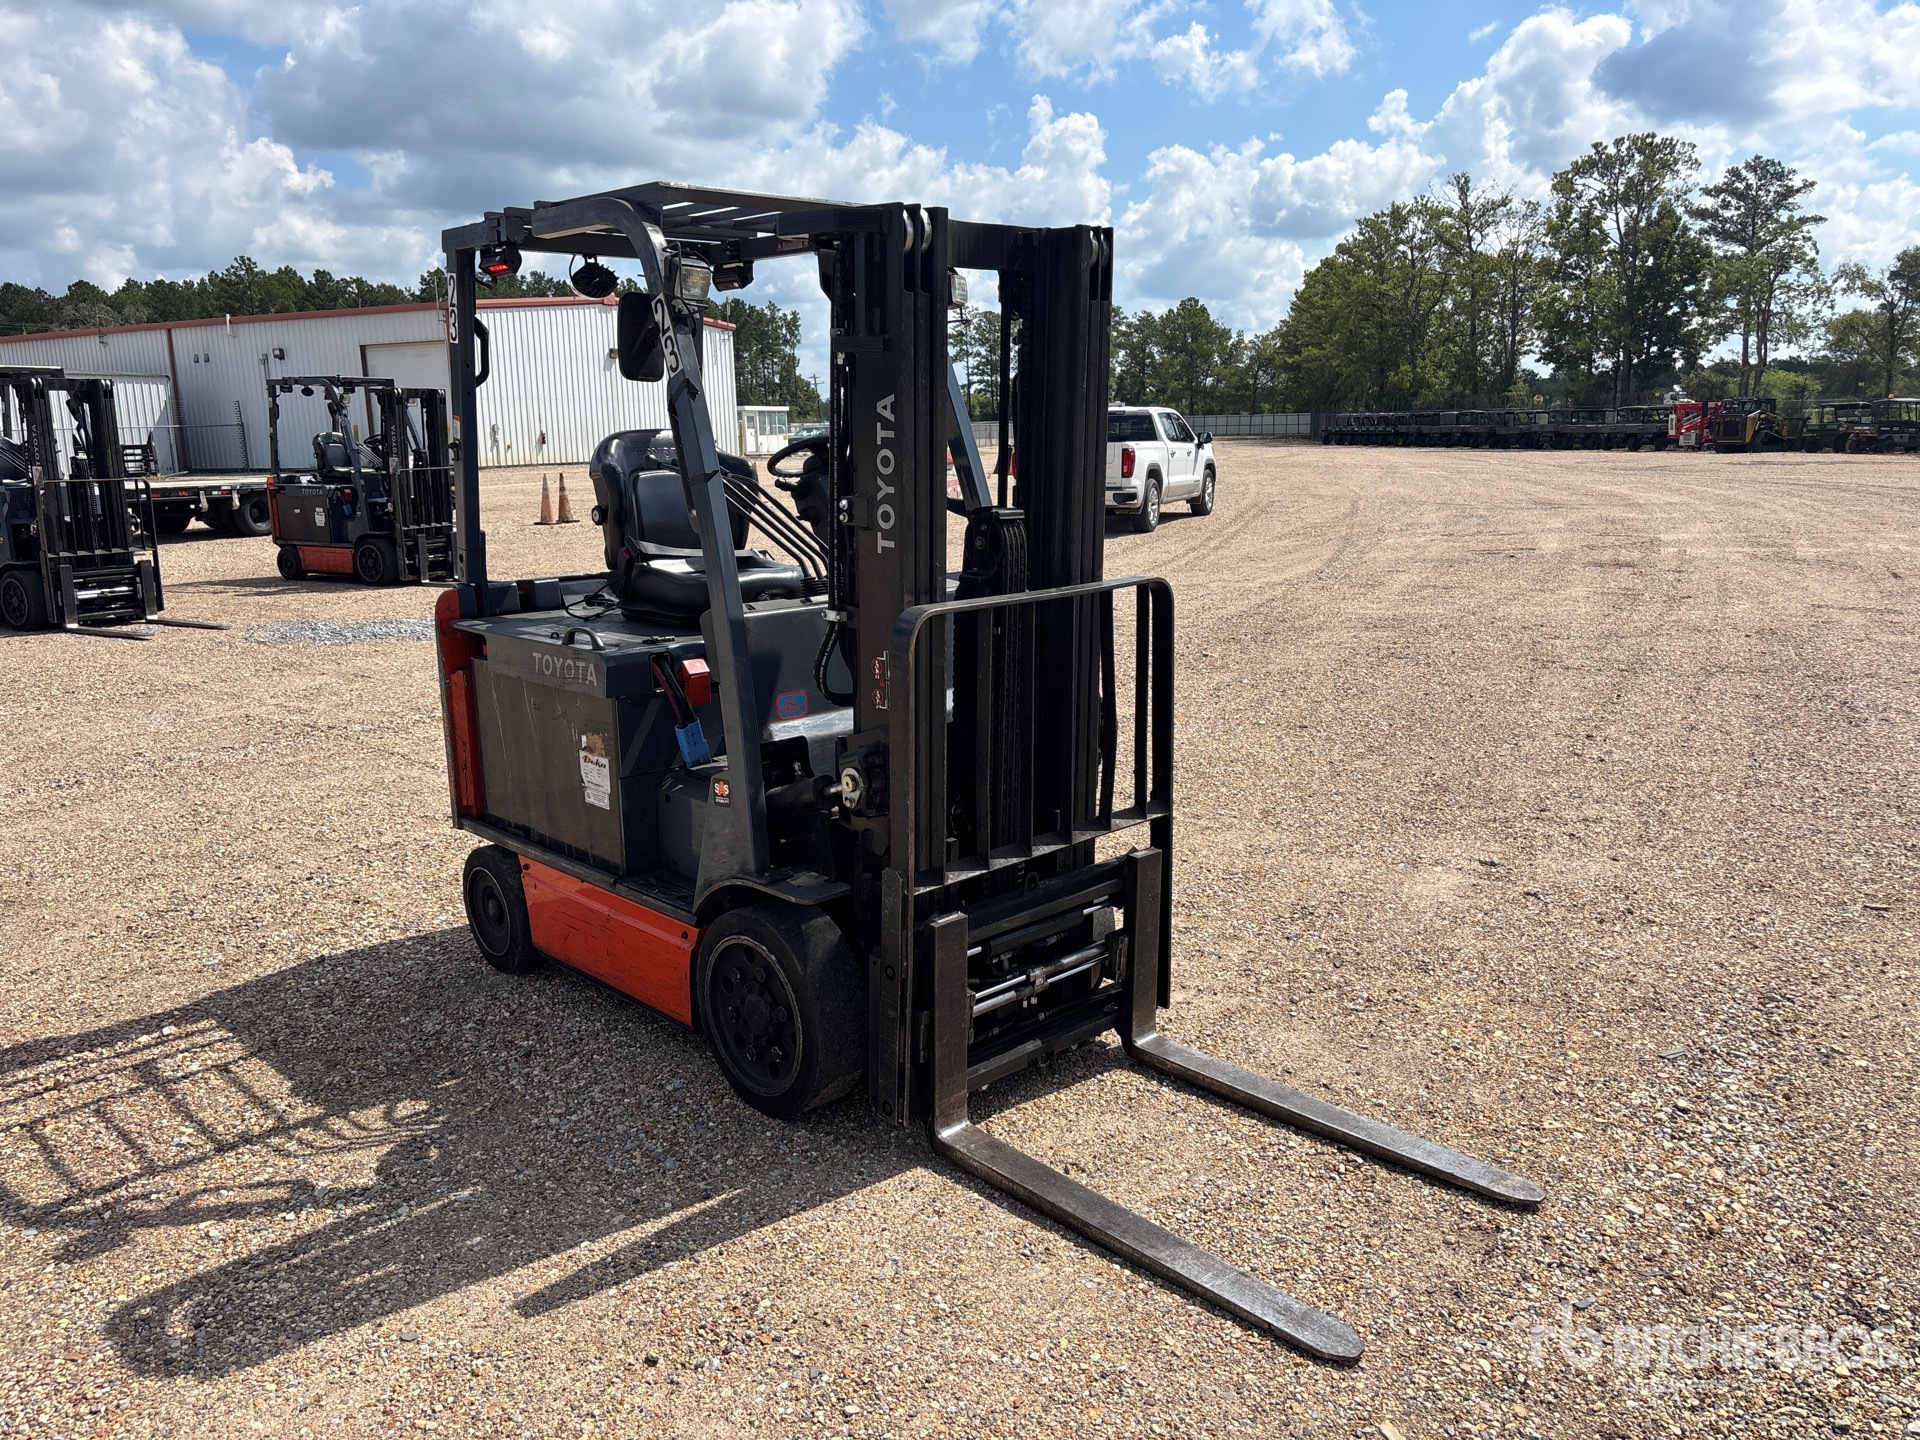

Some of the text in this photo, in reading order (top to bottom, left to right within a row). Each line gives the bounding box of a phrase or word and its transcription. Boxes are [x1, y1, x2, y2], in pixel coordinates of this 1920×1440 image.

[448, 274, 458, 342] 23
[654, 298, 680, 374] 23
[32, 424, 41, 467] TOYOTA
[876, 393, 896, 554] TOYOTA
[532, 651, 598, 687] TOYOTA
